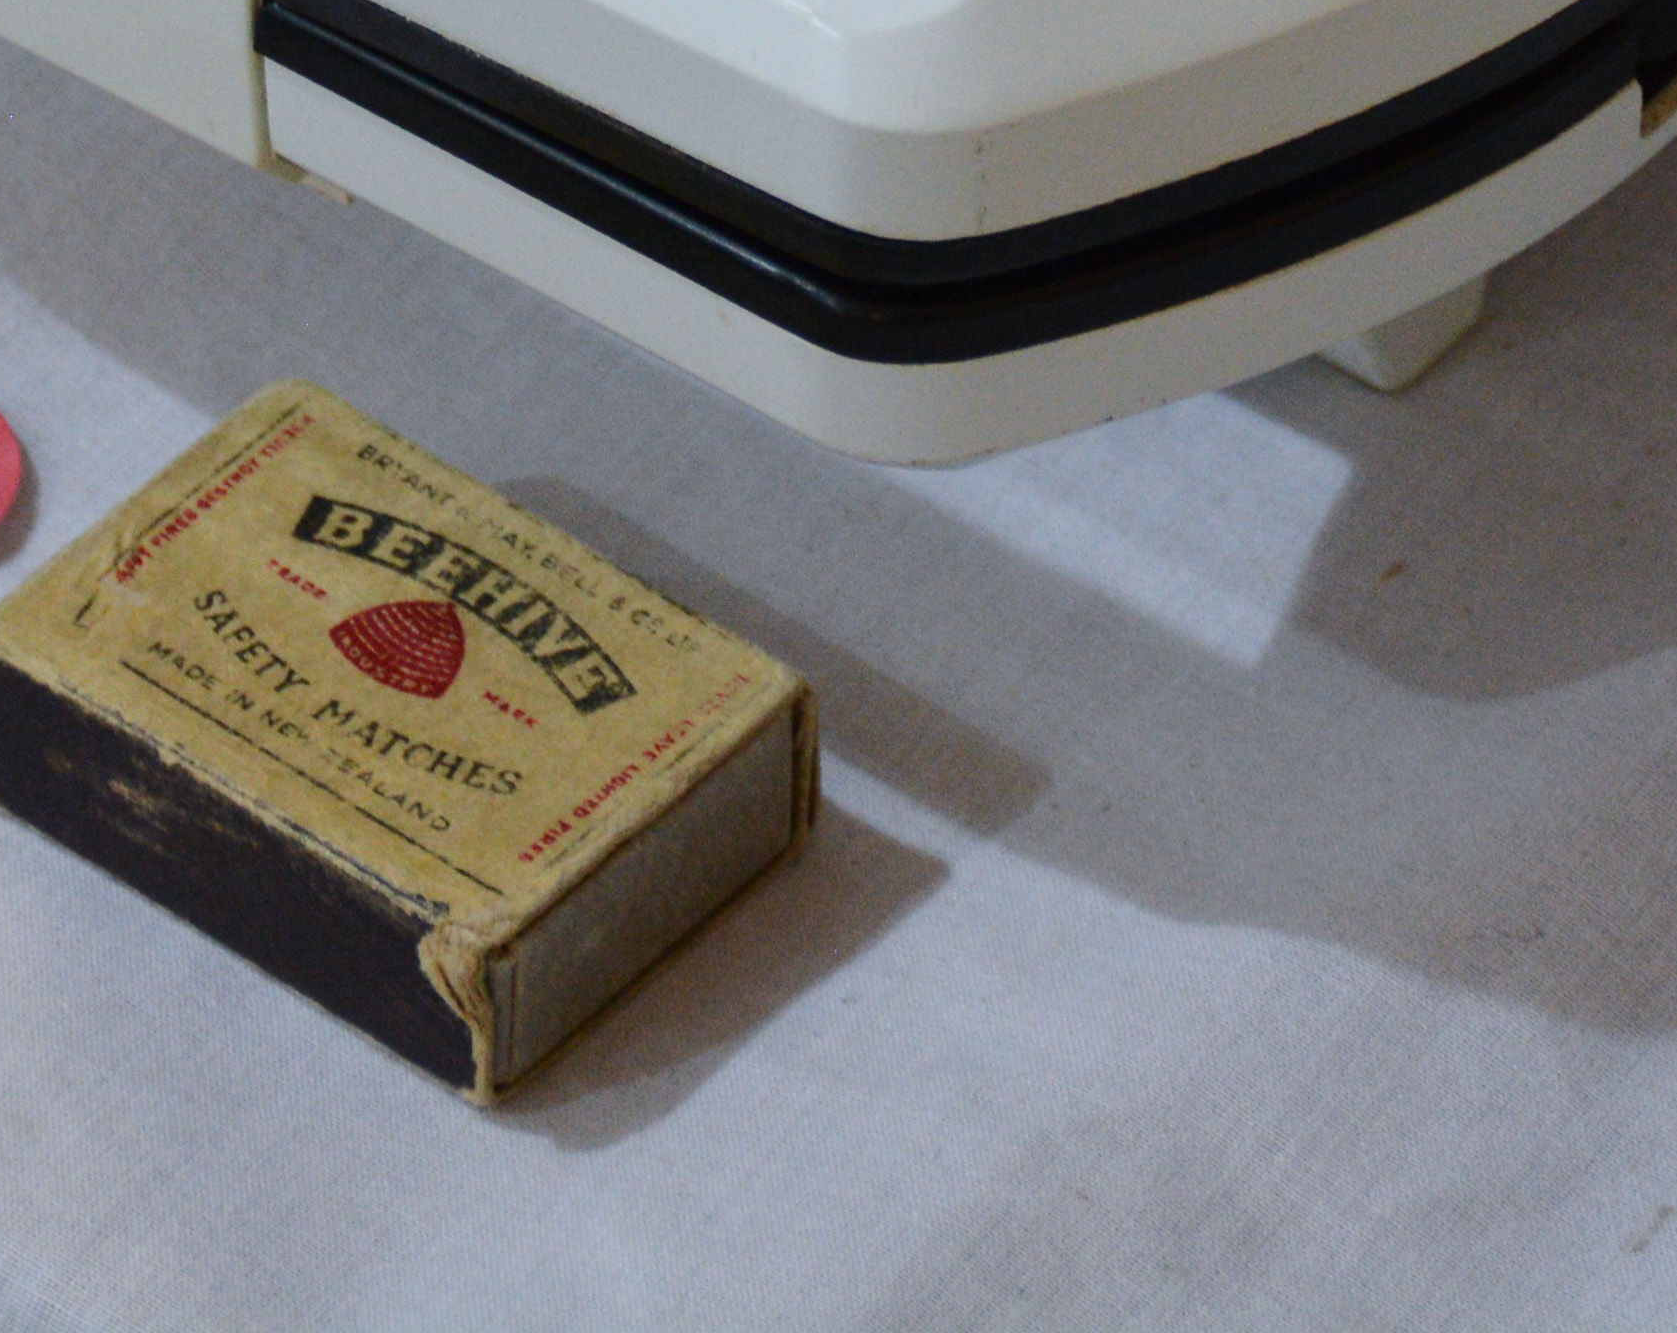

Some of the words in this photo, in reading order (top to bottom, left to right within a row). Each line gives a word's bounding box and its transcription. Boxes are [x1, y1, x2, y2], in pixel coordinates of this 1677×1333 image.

[267, 557, 328, 600] TRADE
[313, 502, 624, 705] BEEHIVE
[148, 640, 221, 692] MADE
[225, 688, 256, 712] IN
[194, 589, 311, 695] SAFETY
[311, 699, 523, 797] MATCHES
[481, 689, 540, 731] MARK
